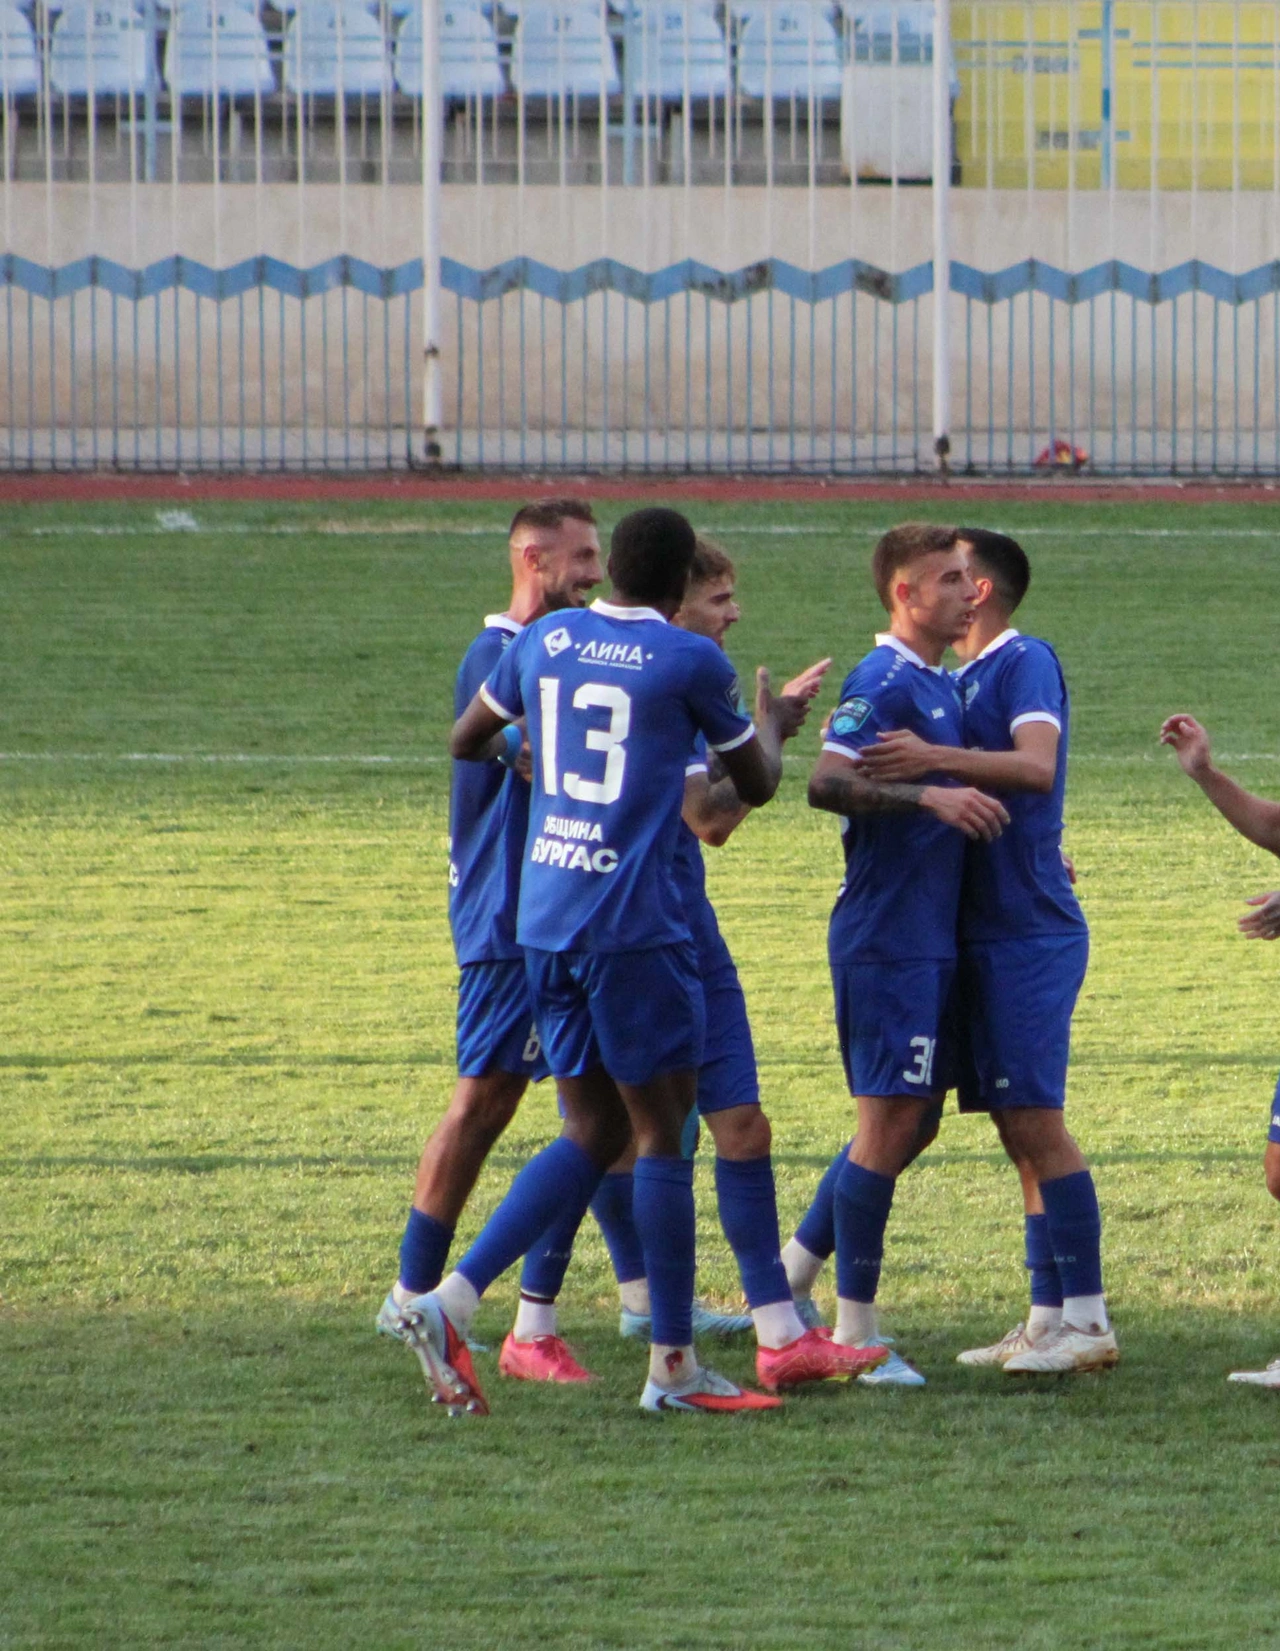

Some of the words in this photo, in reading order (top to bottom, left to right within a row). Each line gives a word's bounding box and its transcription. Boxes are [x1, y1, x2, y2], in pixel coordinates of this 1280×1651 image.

[580, 641, 643, 664] ЛИНА
[539, 677, 631, 804] 13
[543, 815, 603, 842] ОБЩИНА
[531, 837, 619, 874] БУРГАС
